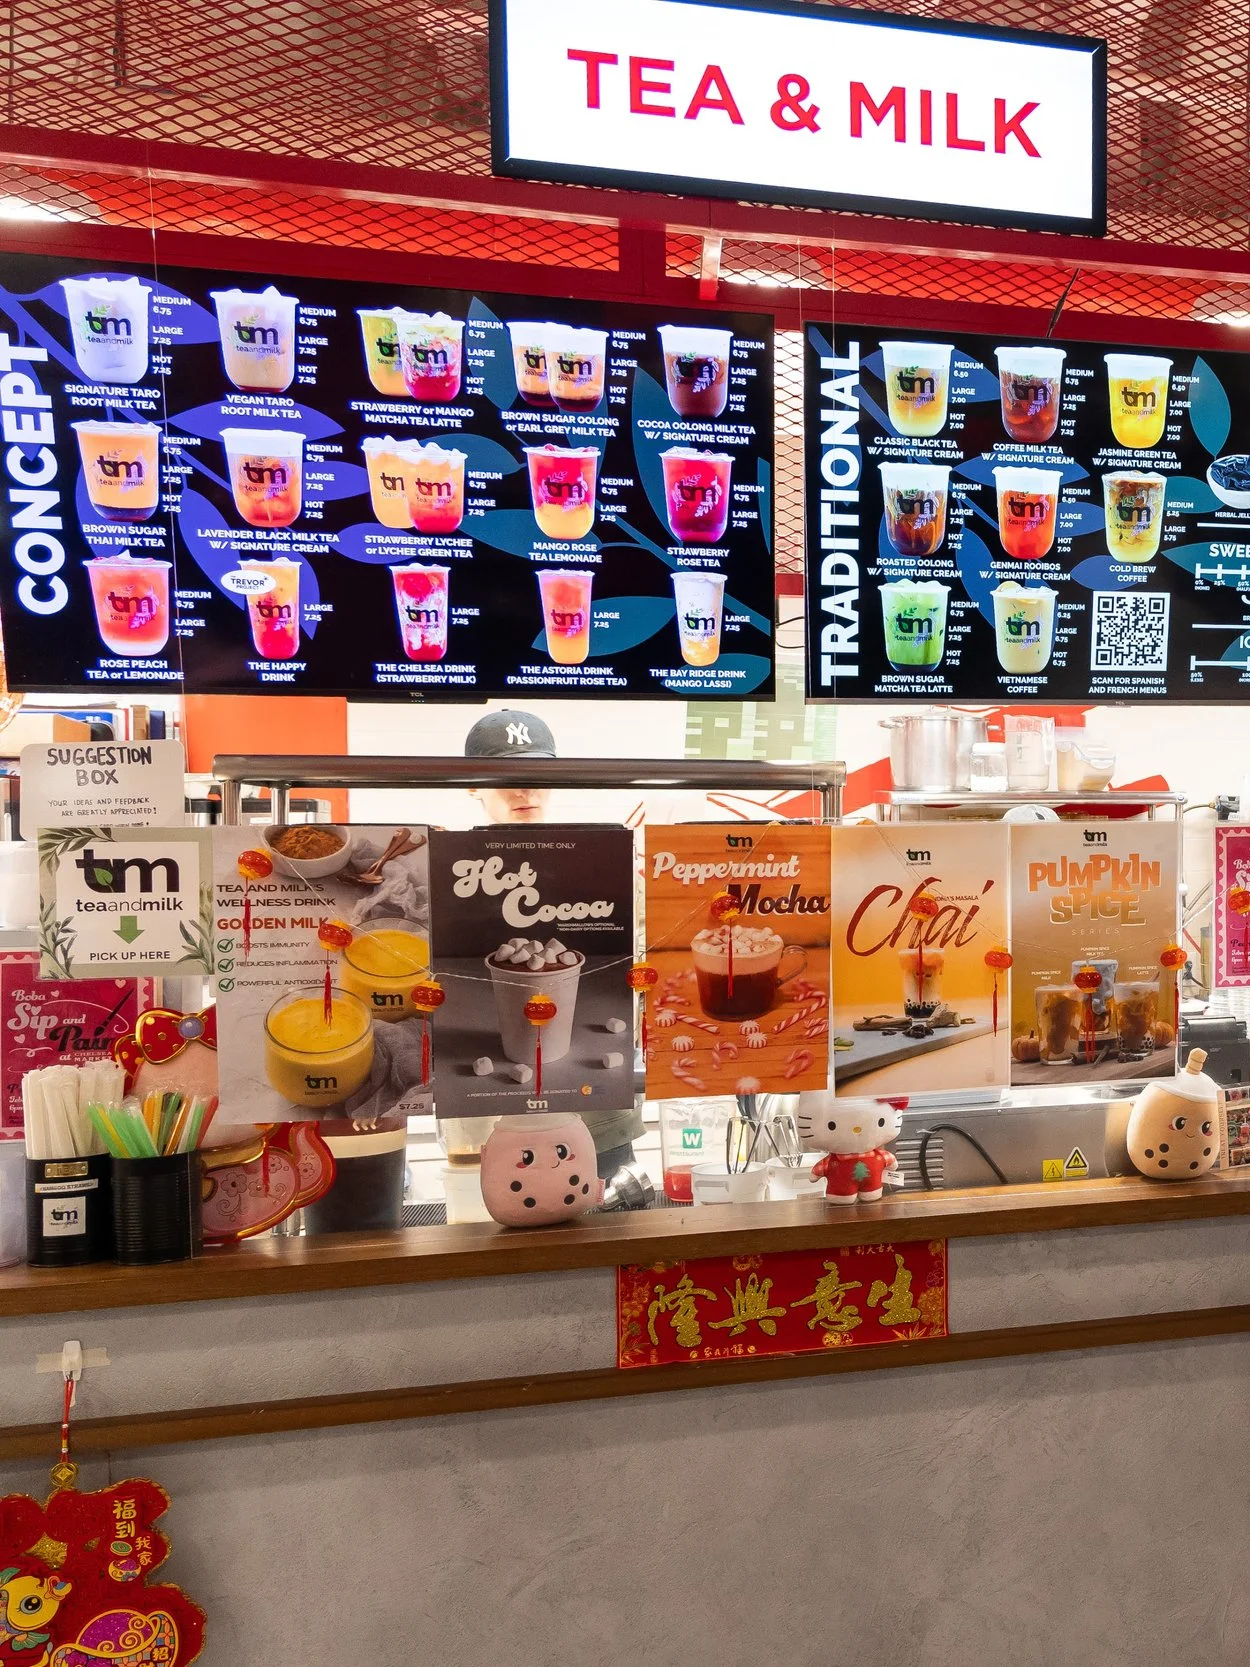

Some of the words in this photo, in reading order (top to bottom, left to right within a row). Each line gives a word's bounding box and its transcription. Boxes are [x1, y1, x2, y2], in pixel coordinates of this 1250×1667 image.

[567, 48, 745, 126] TEA
[769, 73, 821, 134] &
[849, 81, 1042, 158] MILK
[153, 296, 191, 306] MEDIUM
[153, 306, 172, 316] 6.75
[153, 326, 184, 336] LARGE
[153, 336, 172, 346] 7.25
[153, 356, 173, 365] HOT
[153, 366, 172, 376] 7.25
[65, 384, 128, 397] SIGNATURE
[131, 388, 161, 399] TARO
[72, 397, 103, 408] ROOT
[105, 398, 133, 409] MILK
[134, 400, 157, 410] TEA
[874, 437, 910, 446] CLASSIC
[912, 439, 940, 447] BLACK
[941, 440, 958, 448] TEA
[884, 448, 932, 457] SIGNATURE
[934, 450, 963, 459] CREAM
[0, 333, 69, 614] CONCEPT
[820, 341, 860, 686] TRADITIONAL
[100, 659, 129, 669] ROSE
[131, 659, 168, 669] PEACH
[249, 662, 269, 671] THE
[271, 662, 307, 672] HAPPY
[376, 664, 397, 672] THE
[399, 664, 442, 673] CHELSEA
[444, 665, 476, 674] DRINK
[88, 671, 110, 680] TEA
[112, 672, 122, 680] or
[124, 671, 184, 680] LEMONADE
[262, 672, 295, 682] DRINK
[376, 674, 447, 685] (STRAWBERRY
[449, 675, 477, 685] MILK)
[997, 676, 1048, 685] VIETNAMESE
[1007, 685, 1038, 694] COFFEE
[47, 746, 152, 766] SUGGESTION
[76, 769, 119, 787] BOX
[652, 851, 801, 886] Peppermint
[1027, 853, 1161, 893] PUMPKIN
[452, 855, 537, 898] Hot
[217, 884, 244, 892] TEA
[248, 884, 278, 892] AND
[76, 898, 184, 912] teaandmilk
[294, 898, 336, 906] DRINK
[725, 883, 831, 916] Mocha
[502, 887, 615, 928] Cocoa
[1049, 886, 1147, 927] SPICE
[846, 877, 995, 957] Chai
[1072, 927, 1121, 936] SERIES
[90, 952, 118, 961] PICK
[122, 952, 136, 960] UP
[140, 951, 171, 960] HERE
[11, 989, 46, 1002] Boba
[7, 1002, 58, 1040] Sip
[63, 1014, 86, 1025] and
